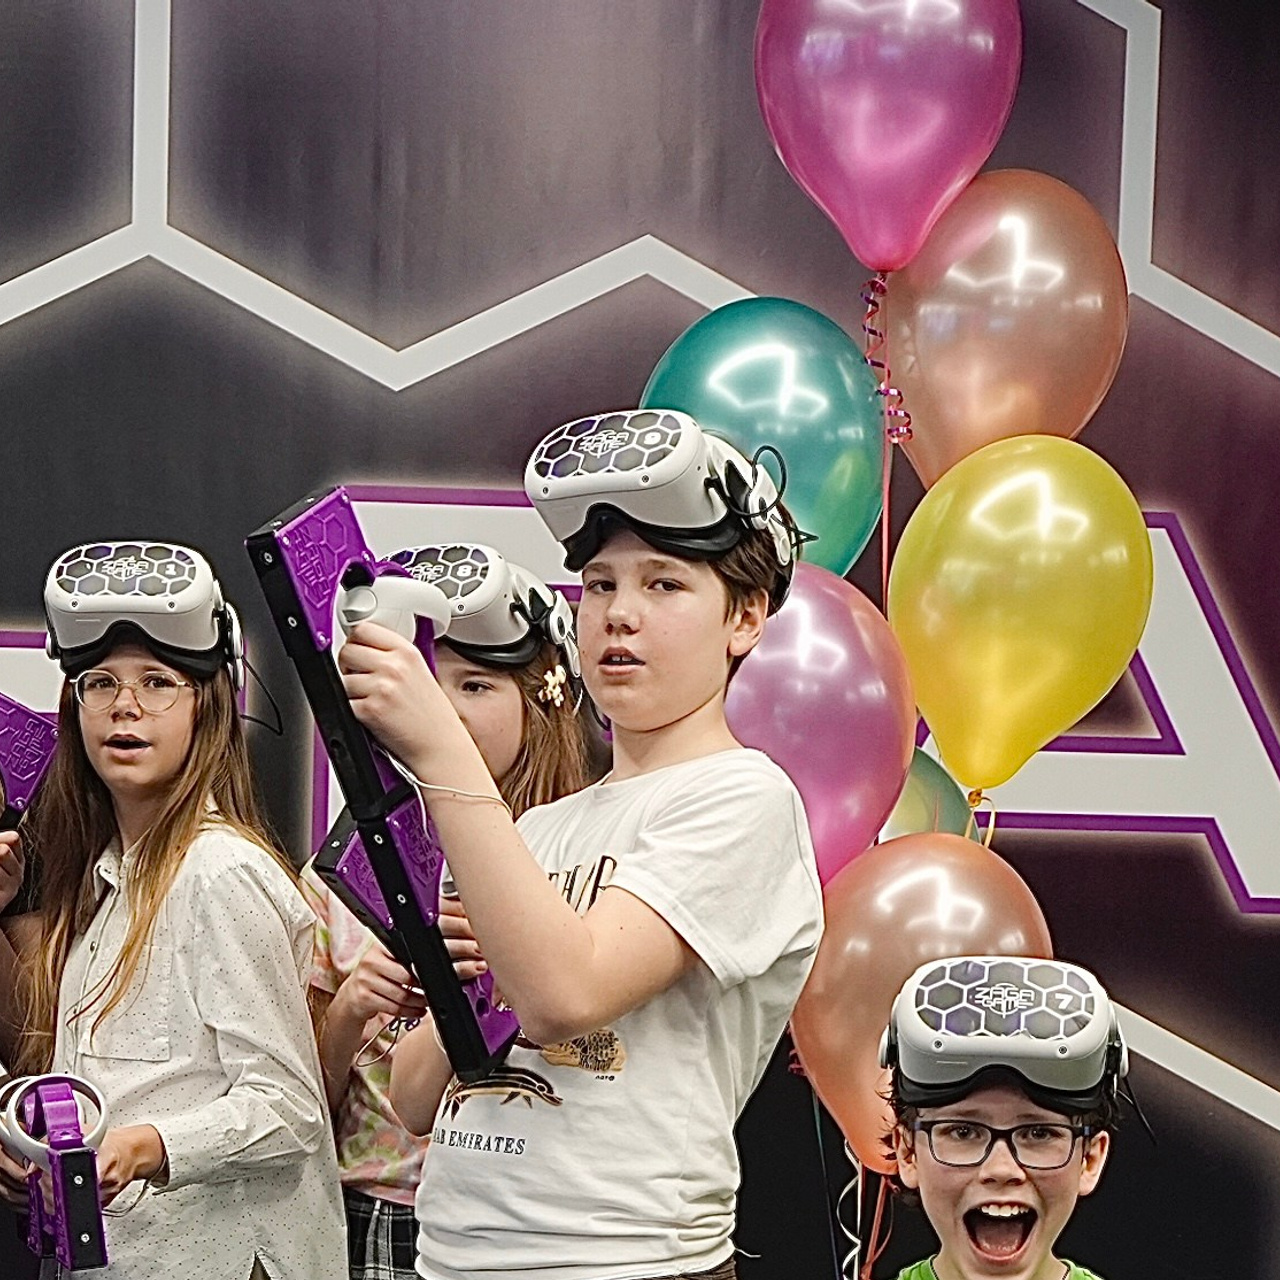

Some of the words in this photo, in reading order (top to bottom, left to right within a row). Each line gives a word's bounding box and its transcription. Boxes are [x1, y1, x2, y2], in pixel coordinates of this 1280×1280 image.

[581, 430, 629, 445] ZAGA
[644, 432, 661, 444] 9
[102, 561, 148, 570] ZAGA
[165, 564, 176, 575] 1
[457, 565, 471, 577] 8
[975, 987, 1034, 1001] ZAGA
[1054, 993, 1073, 1009] 7
[975, 998, 1033, 1013] GAME
[448, 1130, 526, 1155] EMIRATES
